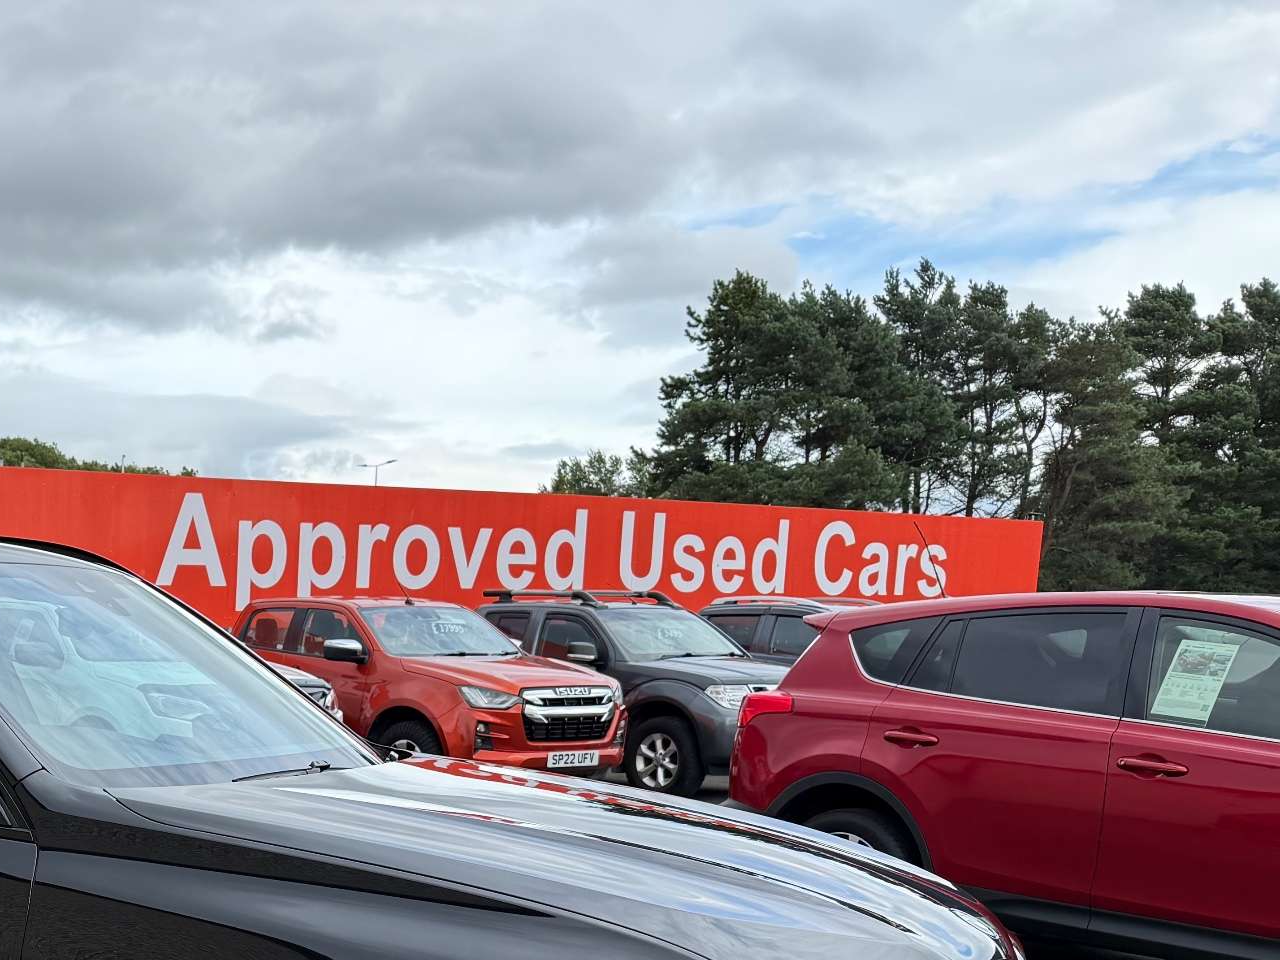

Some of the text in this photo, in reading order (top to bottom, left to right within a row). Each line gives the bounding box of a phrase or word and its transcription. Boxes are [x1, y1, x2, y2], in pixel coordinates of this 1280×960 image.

[155, 492, 948, 611] Approved Used Cars
[555, 687, 590, 696] ISUZU
[552, 752, 595, 765] SP22 UFV
